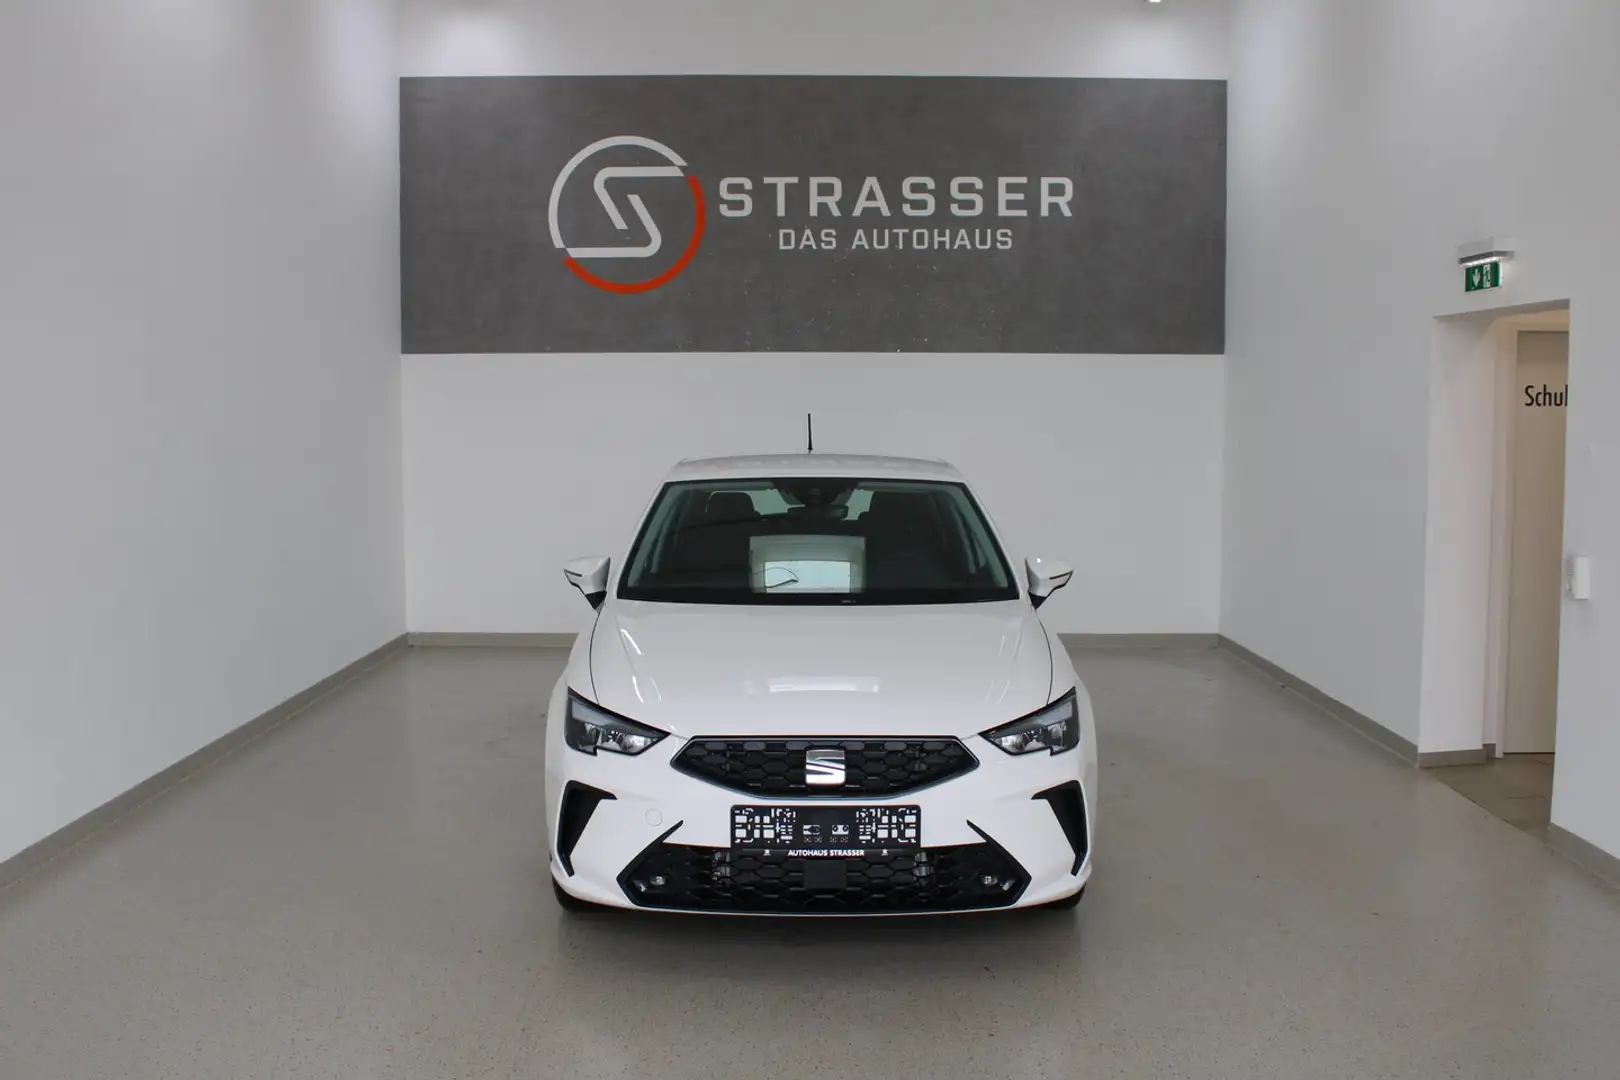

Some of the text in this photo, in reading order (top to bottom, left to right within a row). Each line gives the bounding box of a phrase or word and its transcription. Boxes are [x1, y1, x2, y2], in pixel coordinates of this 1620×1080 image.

[719, 176, 1074, 217] STRASSER
[779, 228, 1013, 250] DAS AUTOHAUS
[1524, 383, 1569, 407] Schul
[787, 849, 865, 857] AUTOHAUS STRASSER
